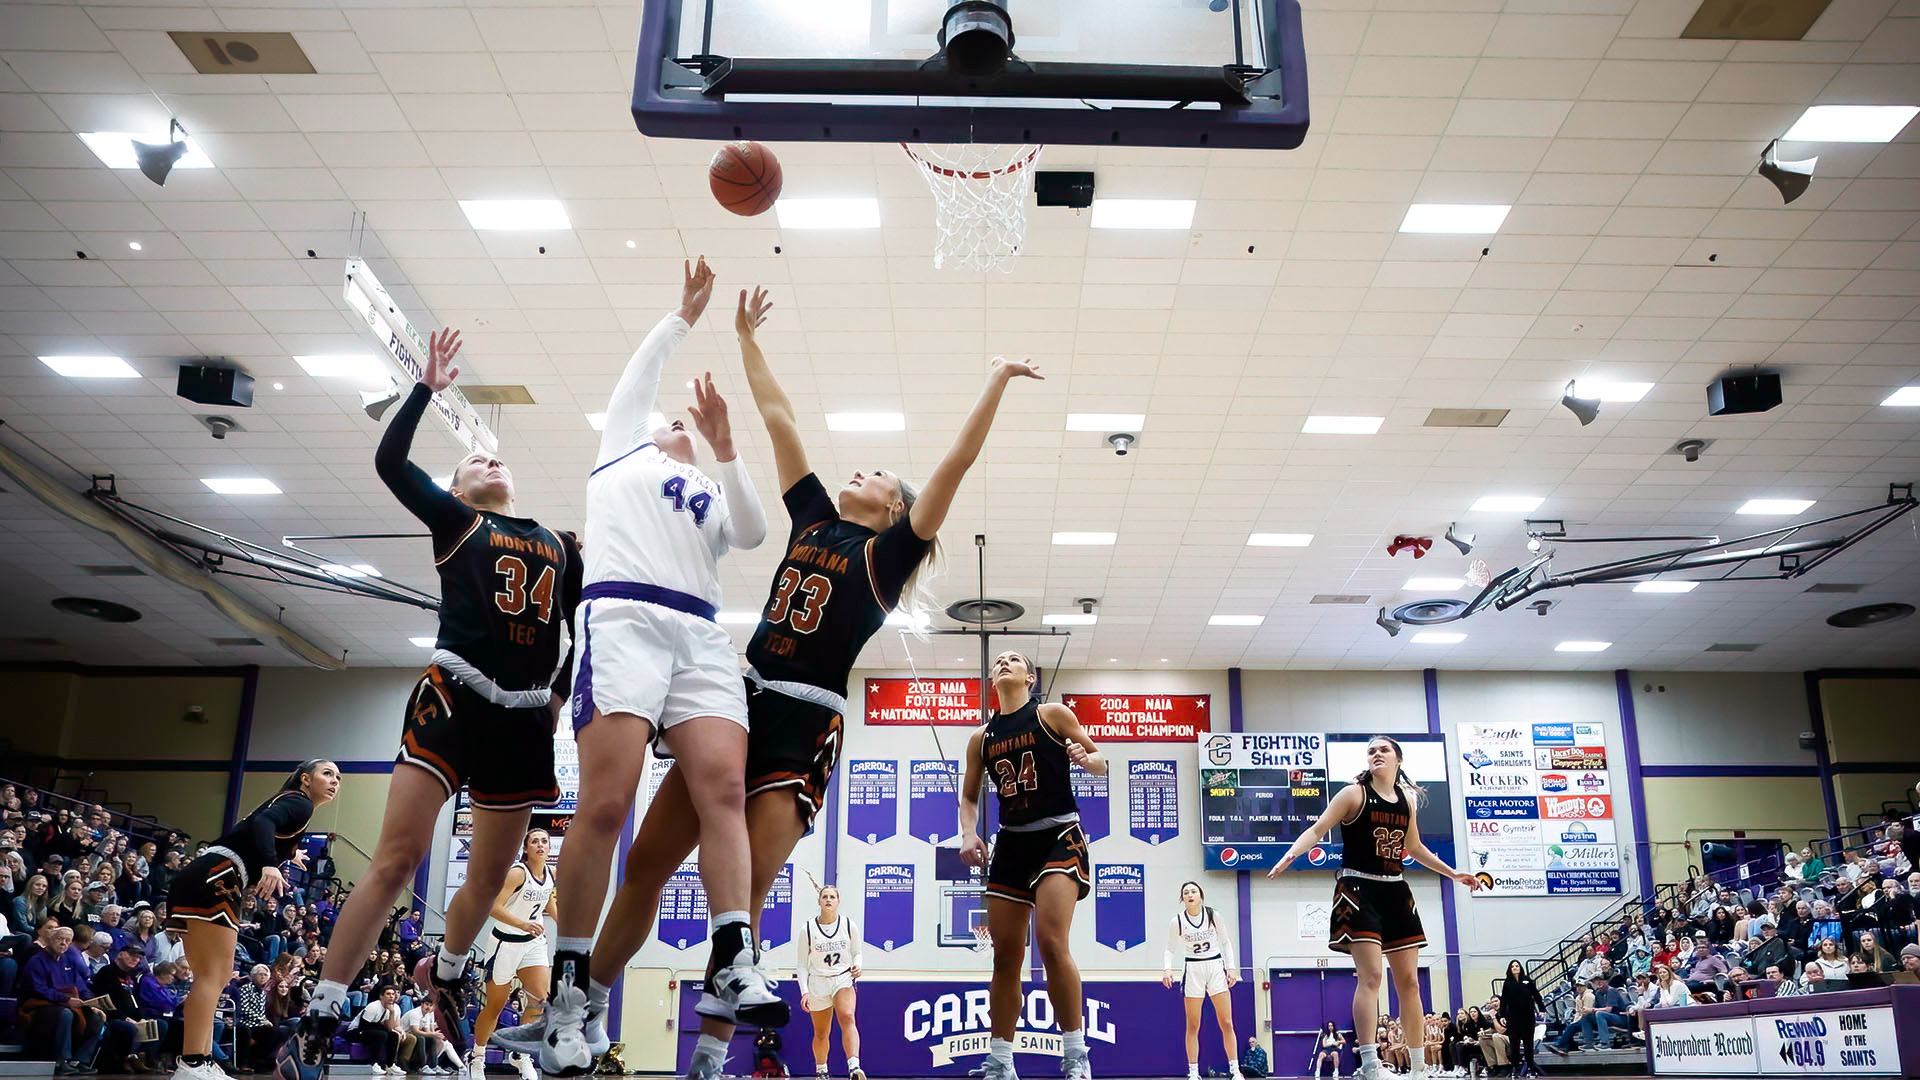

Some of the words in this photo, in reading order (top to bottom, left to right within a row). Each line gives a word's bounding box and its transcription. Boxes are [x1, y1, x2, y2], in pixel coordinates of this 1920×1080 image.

[449, 383, 467, 409] OTORS
[661, 474, 714, 529] 44
[494, 555, 556, 624] 34
[766, 566, 833, 635] 33
[908, 682, 936, 694] 2003
[940, 682, 967, 693] NAIA
[905, 695, 968, 707] FOOTBALL
[1100, 699, 1129, 710] 2004
[1145, 699, 1173, 710] NAIA
[881, 709, 934, 720] NATIONAL
[938, 709, 994, 720] CHAMPIN
[1106, 712, 1166, 723] FOOTBALL
[1080, 725, 1133, 736] NATIONAL
[1136, 725, 1194, 736] CHAMPION
[1481, 729, 1522, 740] Eagle
[1242, 735, 1320, 750] FIGHTING
[1251, 751, 1313, 765] SAINTS
[1553, 759, 1582, 767] Copper
[852, 762, 895, 773] CARROLL
[1131, 762, 1174, 773] CARROLL
[995, 751, 1038, 798] 24
[1470, 773, 1529, 786] RUCKERS
[1370, 811, 1408, 826] MONTAN
[1470, 822, 1499, 832] HAC
[1373, 827, 1405, 859] 22
[1240, 852, 1263, 861] pepsi
[1564, 847, 1615, 859] Miller's
[868, 866, 911, 877] CARROLL
[1098, 866, 1141, 877] CARROLL
[1495, 877, 1546, 886] OrthoRehab
[529, 903, 541, 920] 2
[1193, 942, 1211, 954] 23
[824, 953, 841, 967] 42
[1317, 959, 1328, 967] EXIT
[1775, 1016, 1827, 1038] REWIND
[1839, 1014, 1867, 1030] HOME
[1021, 1036, 1062, 1052] SAINT
[1656, 1034, 1712, 1062] Independent
[1714, 1030, 1753, 1056] Record
[1844, 1035, 1853, 1046] OF
[1854, 1035, 1867, 1046] THE
[1794, 1040, 1826, 1066] 94.9
[1840, 1050, 1877, 1066] SAINTS
